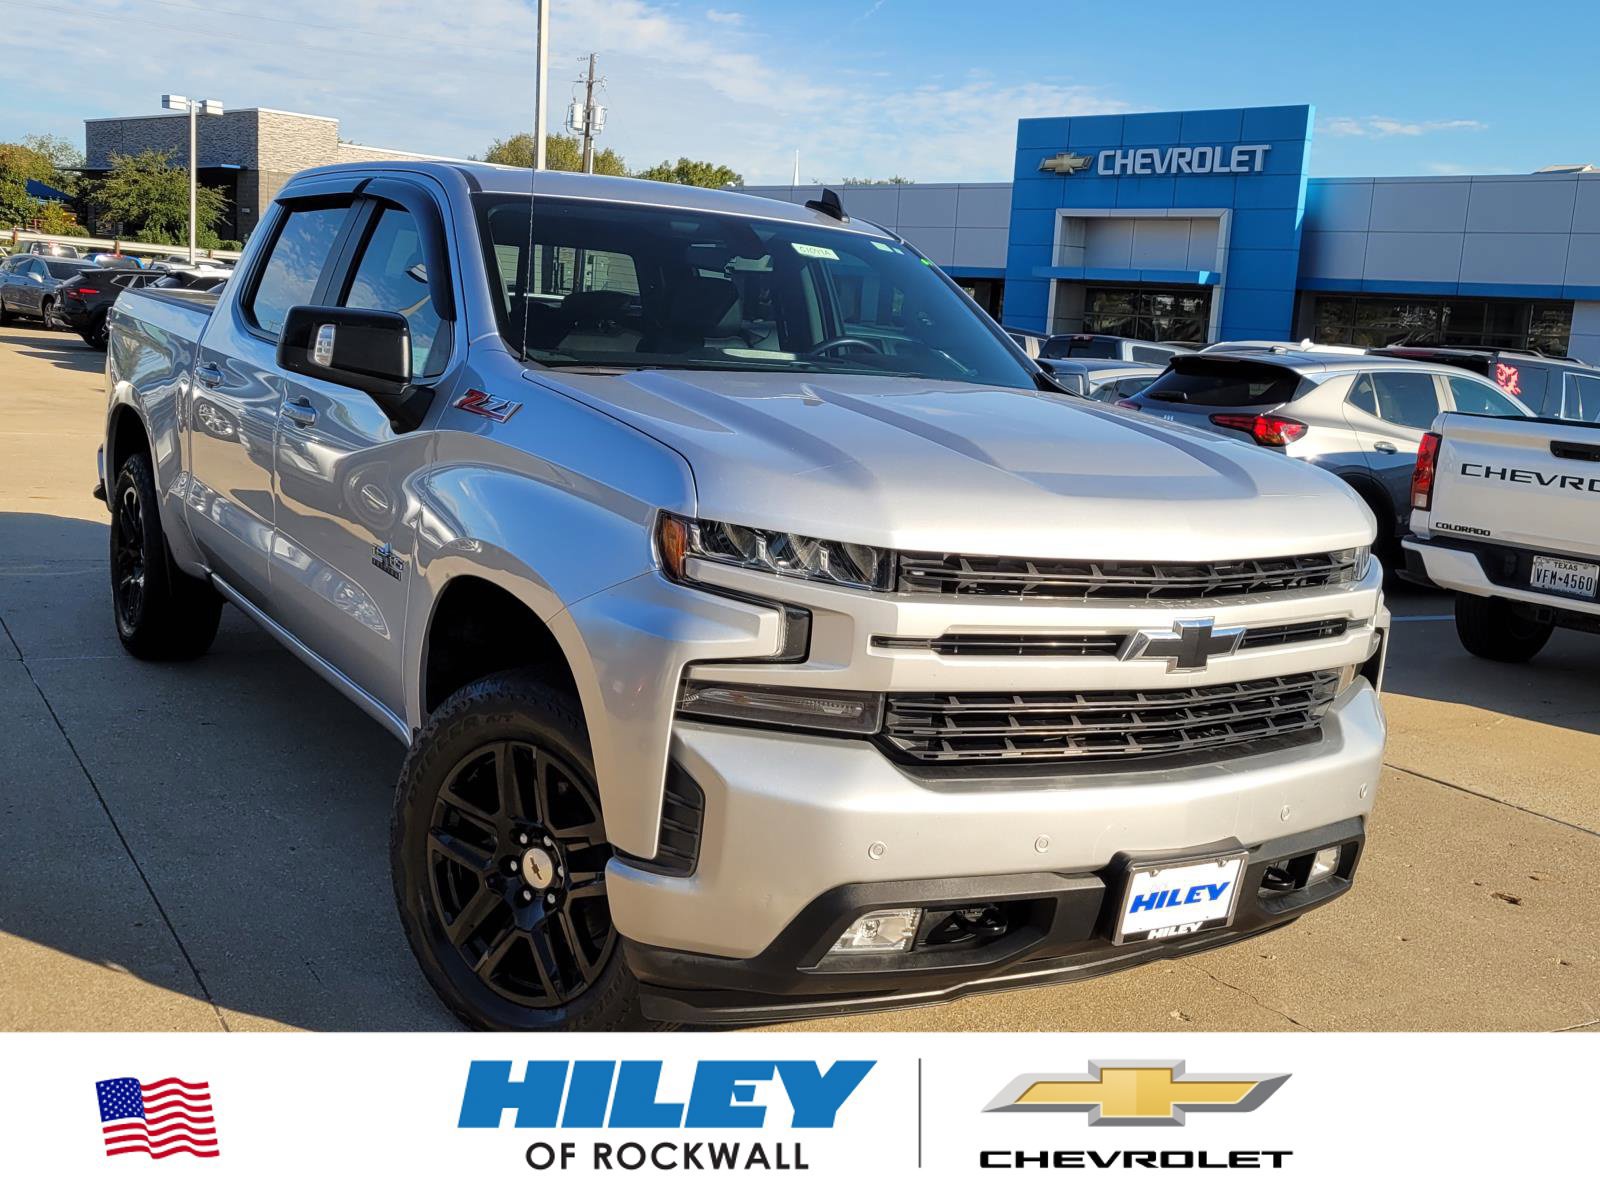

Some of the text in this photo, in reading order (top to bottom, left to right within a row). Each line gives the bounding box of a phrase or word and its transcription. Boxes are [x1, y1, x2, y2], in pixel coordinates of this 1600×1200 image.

[1097, 144, 1271, 175] CHEVROLET
[453, 388, 523, 423] Z71
[1435, 521, 1491, 537] COLORADO
[1554, 561, 1578, 571] TEXAS
[1128, 881, 1231, 914] HILEY
[1147, 921, 1204, 940] HILEY
